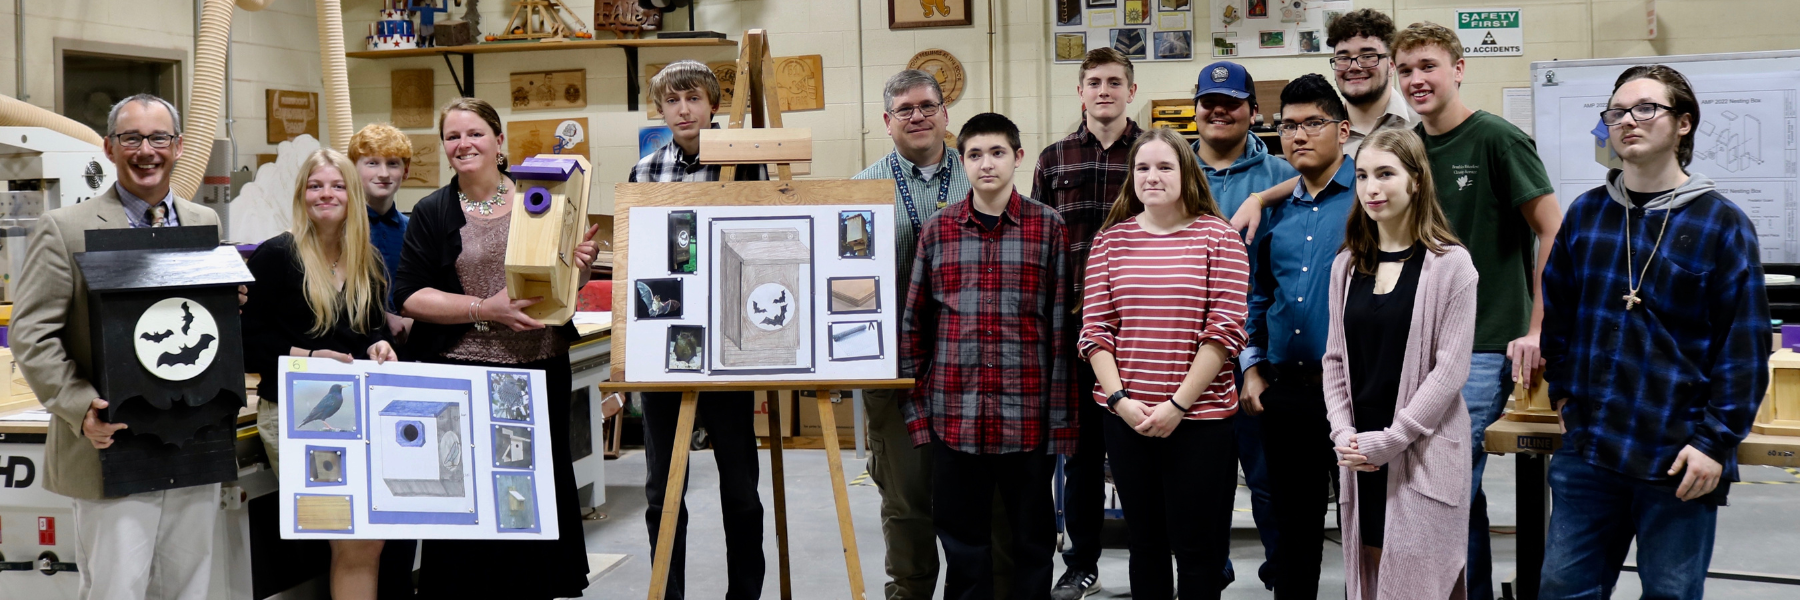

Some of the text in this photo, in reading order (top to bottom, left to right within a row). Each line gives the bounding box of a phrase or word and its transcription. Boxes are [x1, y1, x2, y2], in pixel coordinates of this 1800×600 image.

[1461, 12, 1516, 23] SAFETY
[292, 359, 301, 370] 6
[1519, 437, 1551, 448] ULINE
